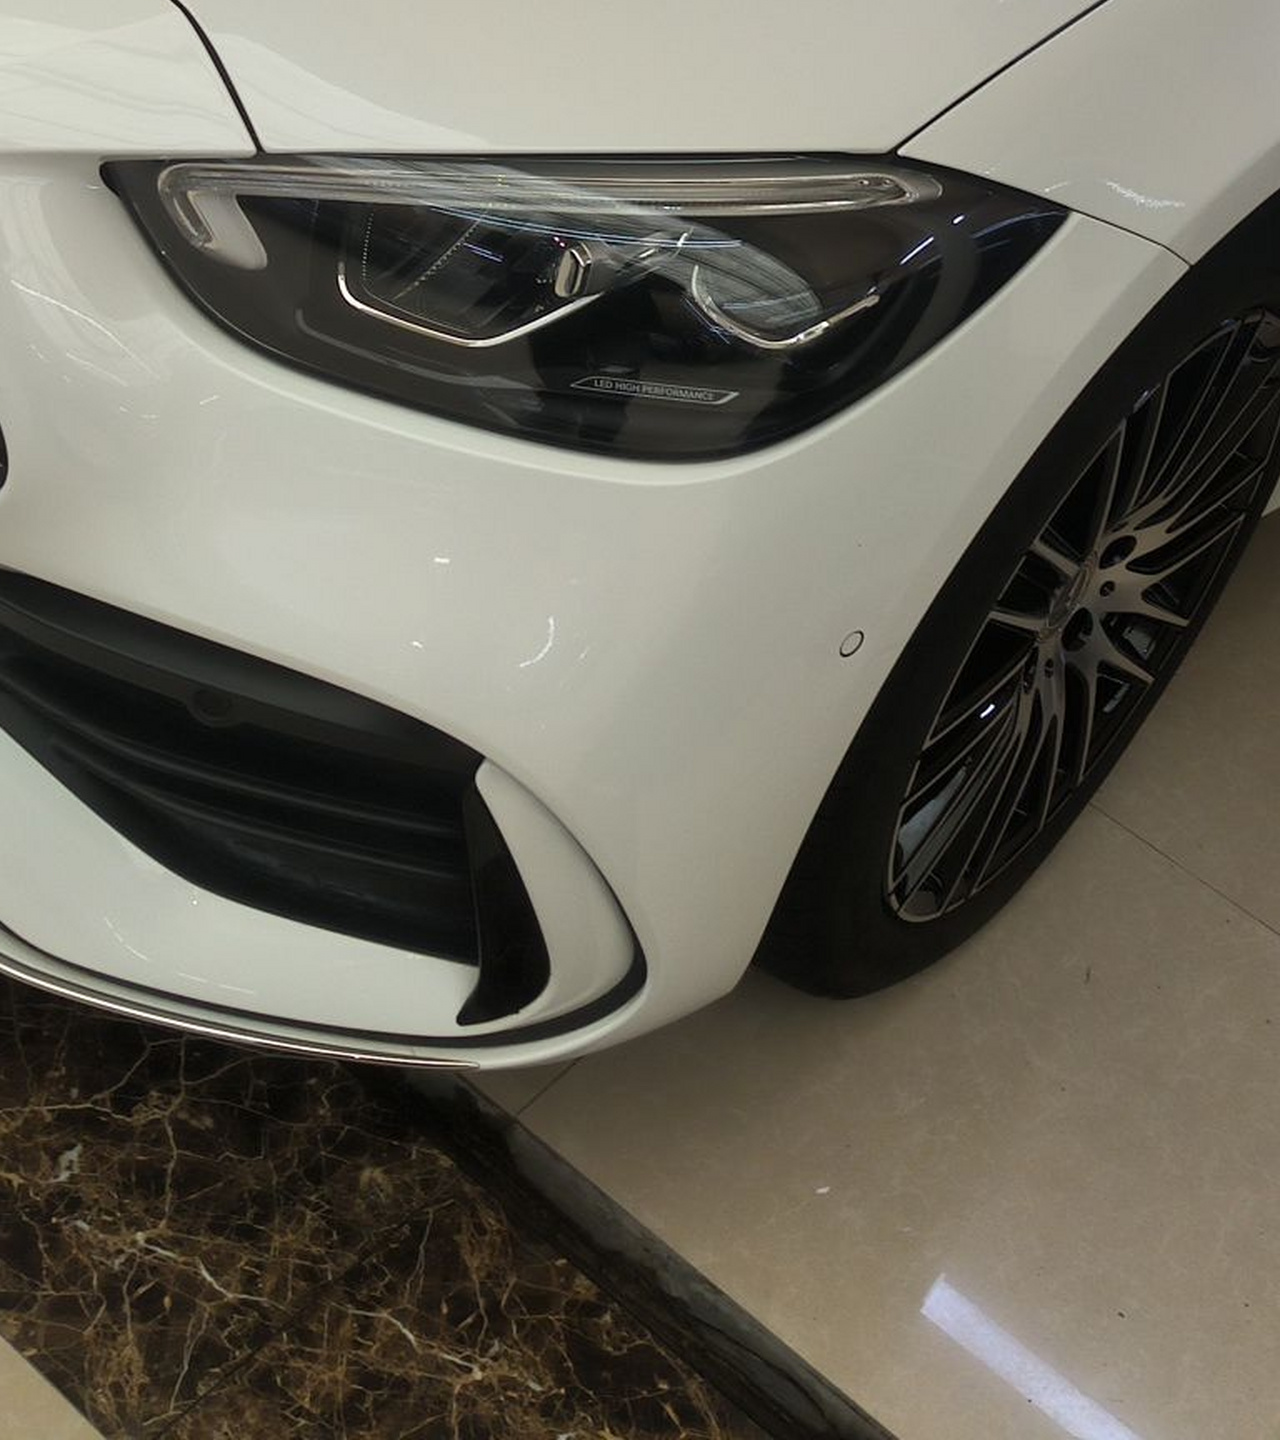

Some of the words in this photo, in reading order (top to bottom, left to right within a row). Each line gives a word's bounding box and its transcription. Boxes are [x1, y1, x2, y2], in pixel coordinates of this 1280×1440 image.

[593, 379, 613, 389] LED
[615, 383, 639, 393] HIGH
[642, 385, 713, 401] PERFORMANCE
